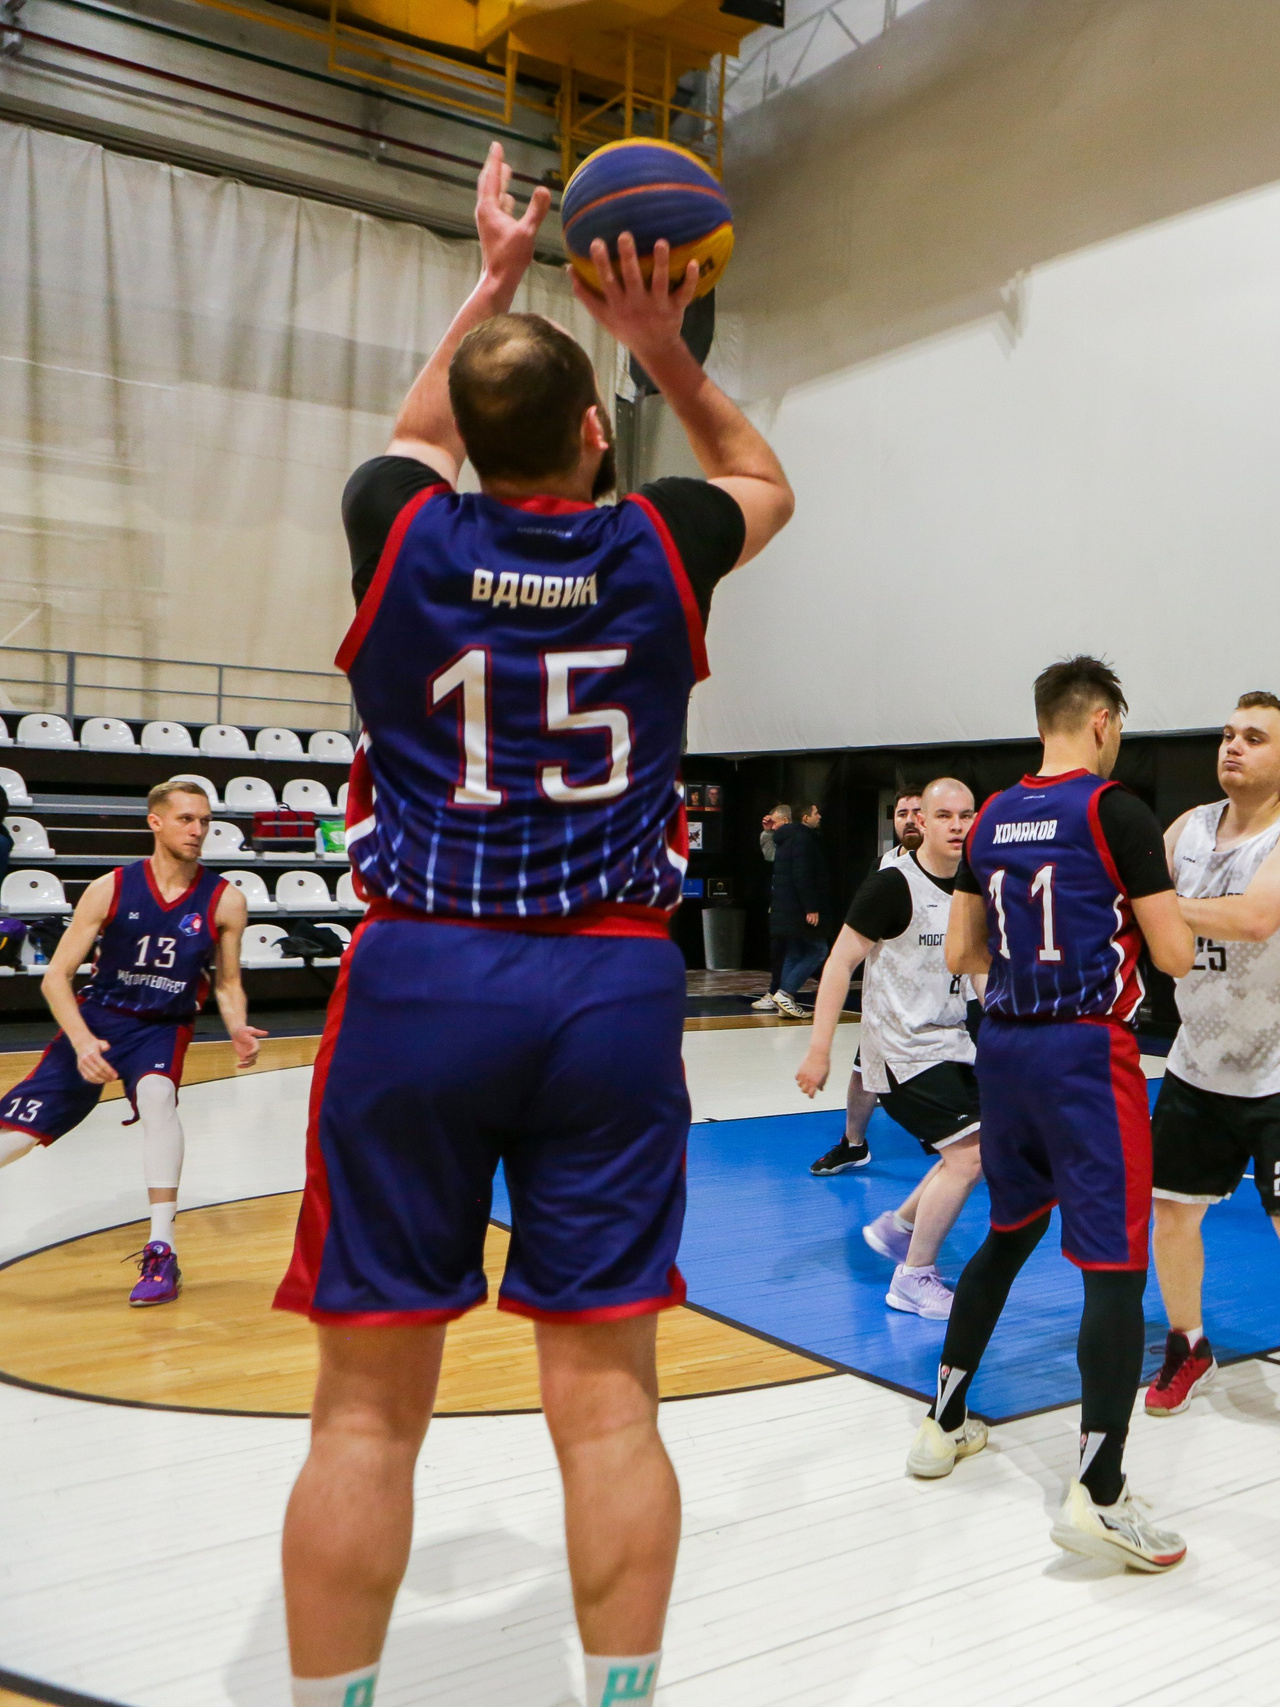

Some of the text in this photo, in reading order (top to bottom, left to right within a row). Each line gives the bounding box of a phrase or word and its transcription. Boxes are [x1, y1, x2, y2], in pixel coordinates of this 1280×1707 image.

[432, 648, 632, 806] 15
[988, 865, 1062, 961] 11
[134, 935, 176, 969] 13
[918, 933, 946, 946] МОСГ
[4, 1097, 43, 1122] 13
